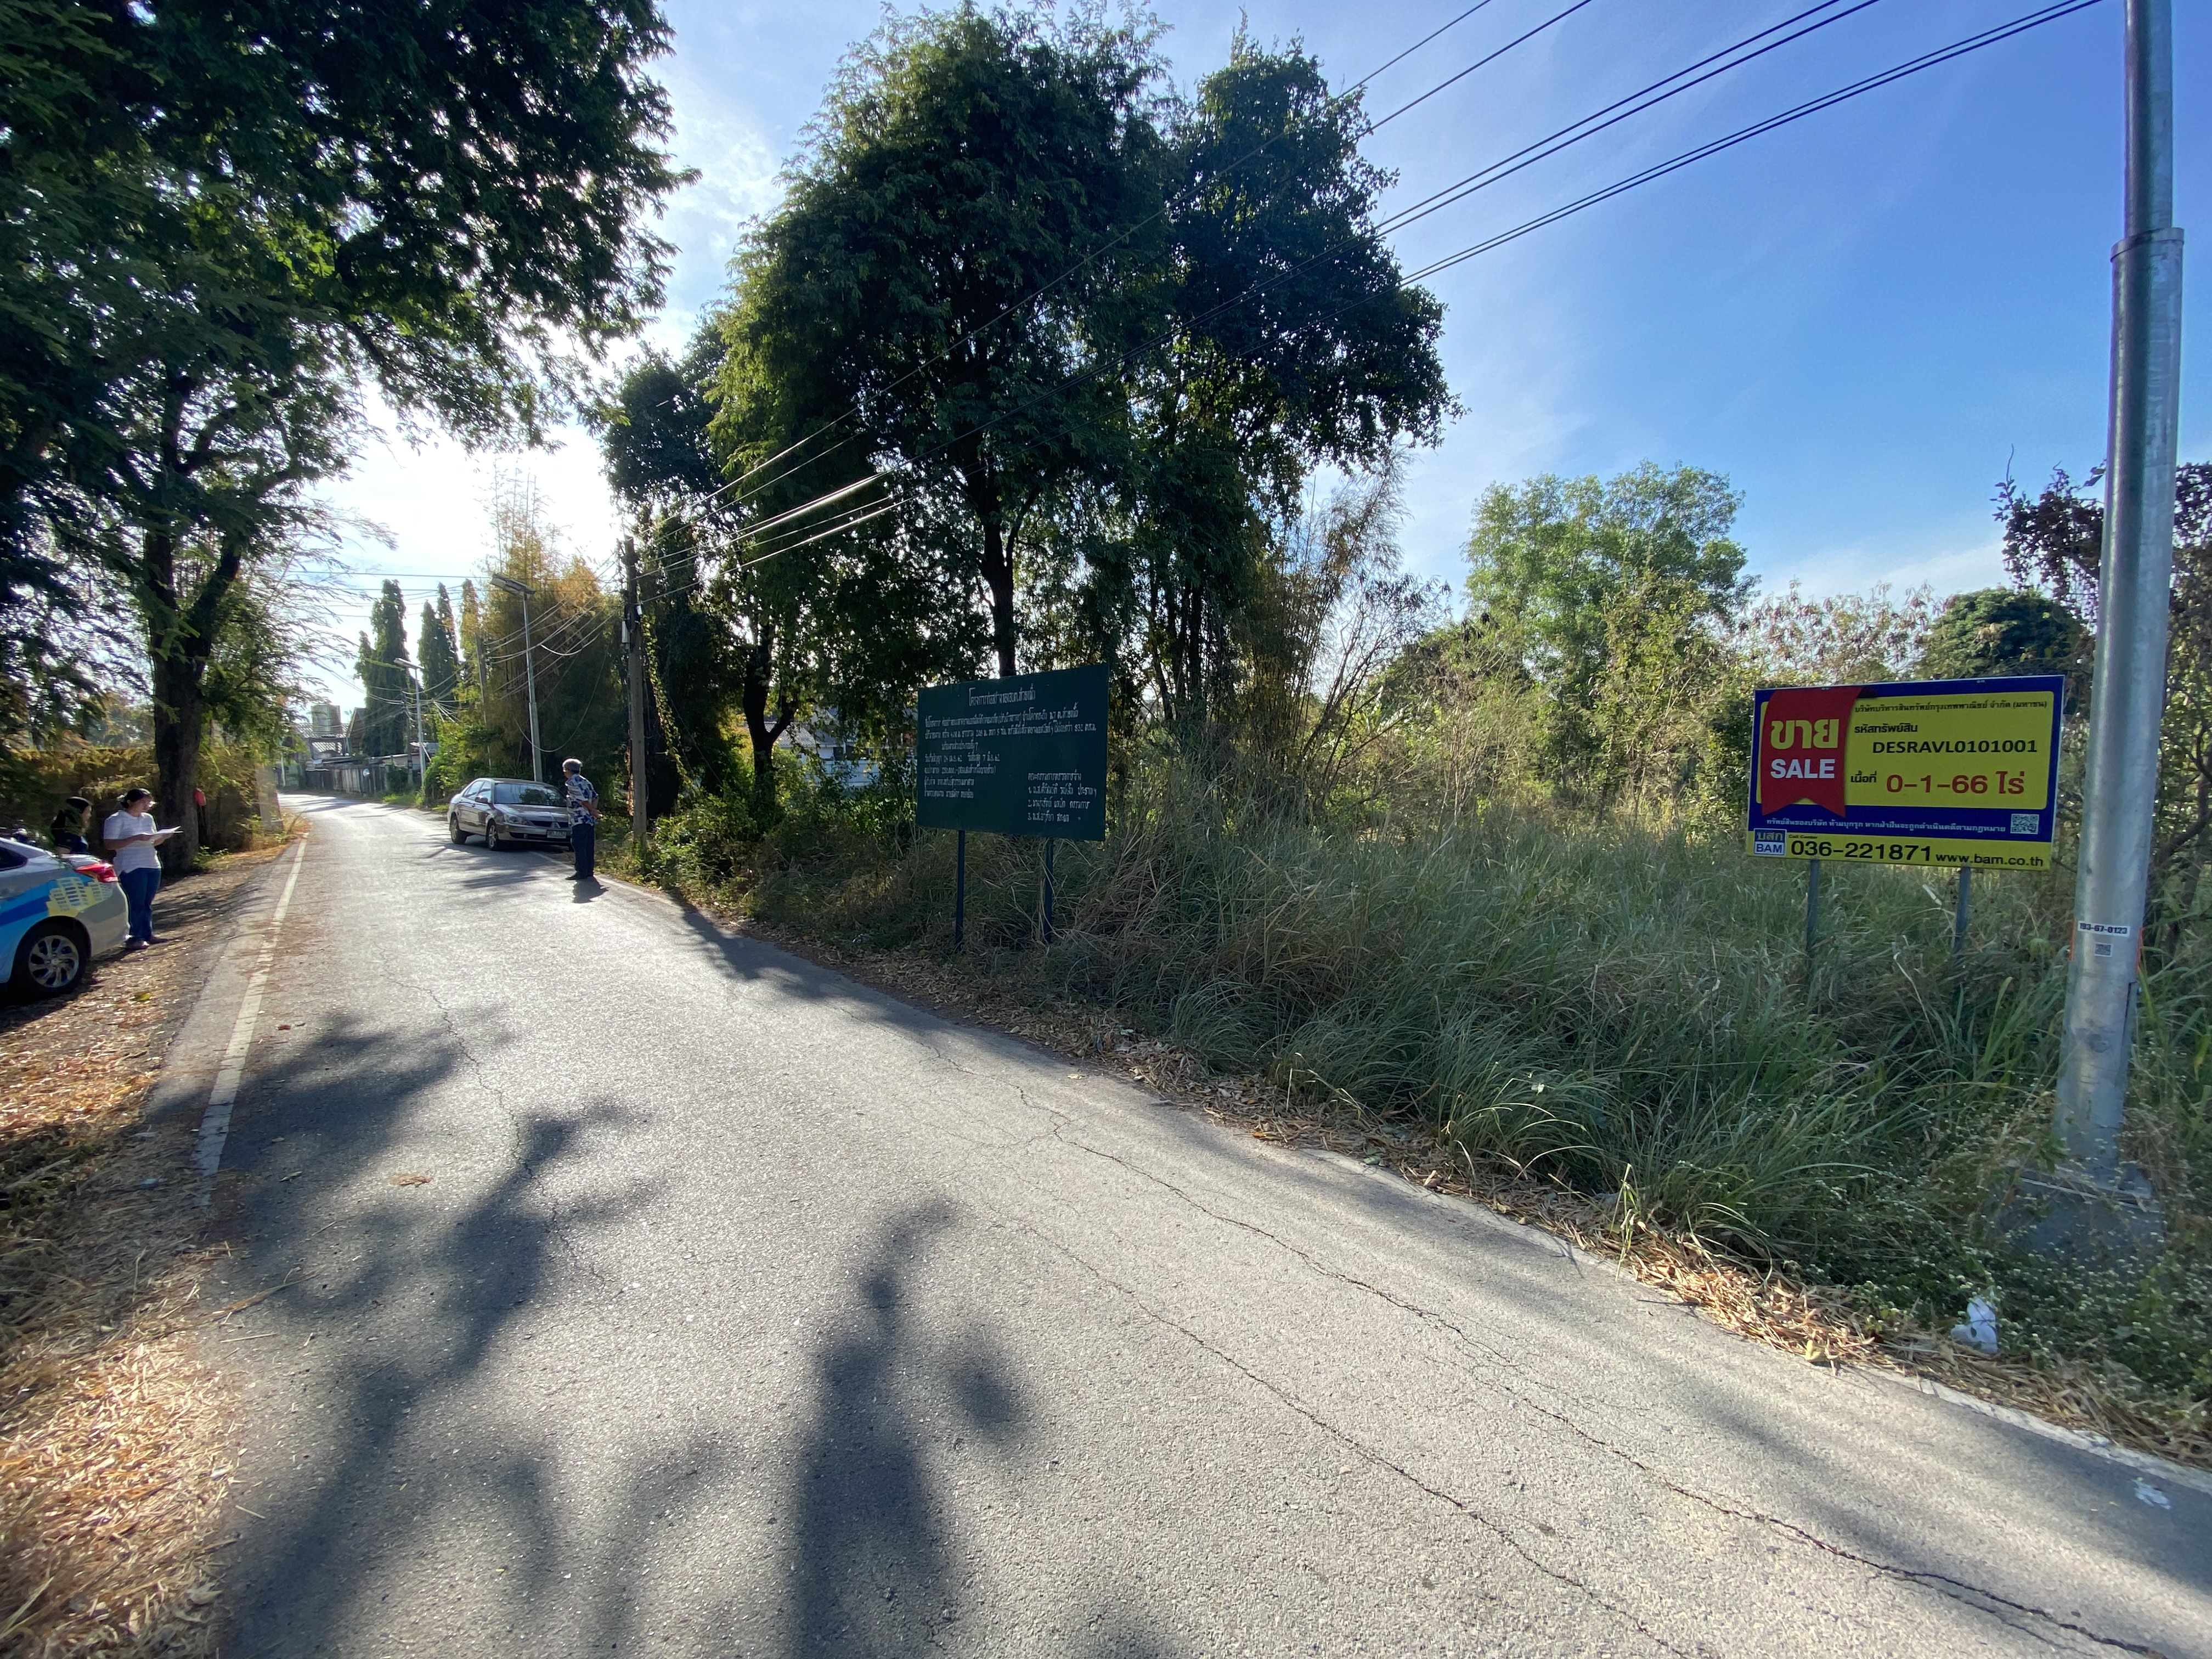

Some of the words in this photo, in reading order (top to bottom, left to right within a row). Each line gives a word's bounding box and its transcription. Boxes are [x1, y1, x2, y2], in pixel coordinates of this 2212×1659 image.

[1990, 700, 2011, 708] จำกัด
[1770, 719, 1839, 750] ขาย
[1854, 723, 1918, 733] รหัสทรัพย์สิน
[1872, 740, 2038, 753] DESRAVL0101001
[1770, 758, 1836, 780] SALE
[1851, 770, 1877, 783] เนื้อที่
[1886, 774, 1988, 794] 0-1-66
[1995, 770, 2024, 794] ไร่
[1767, 818, 1827, 826] ทรัพย์สินของบริษัท
[1829, 819, 1863, 829] ห้ามบุกรุก
[1756, 831, 1783, 841] บสก
[1756, 843, 1782, 853] BAM
[1791, 839, 1931, 862] 036-221871
[1936, 853, 2044, 867] www.bam.co.th
